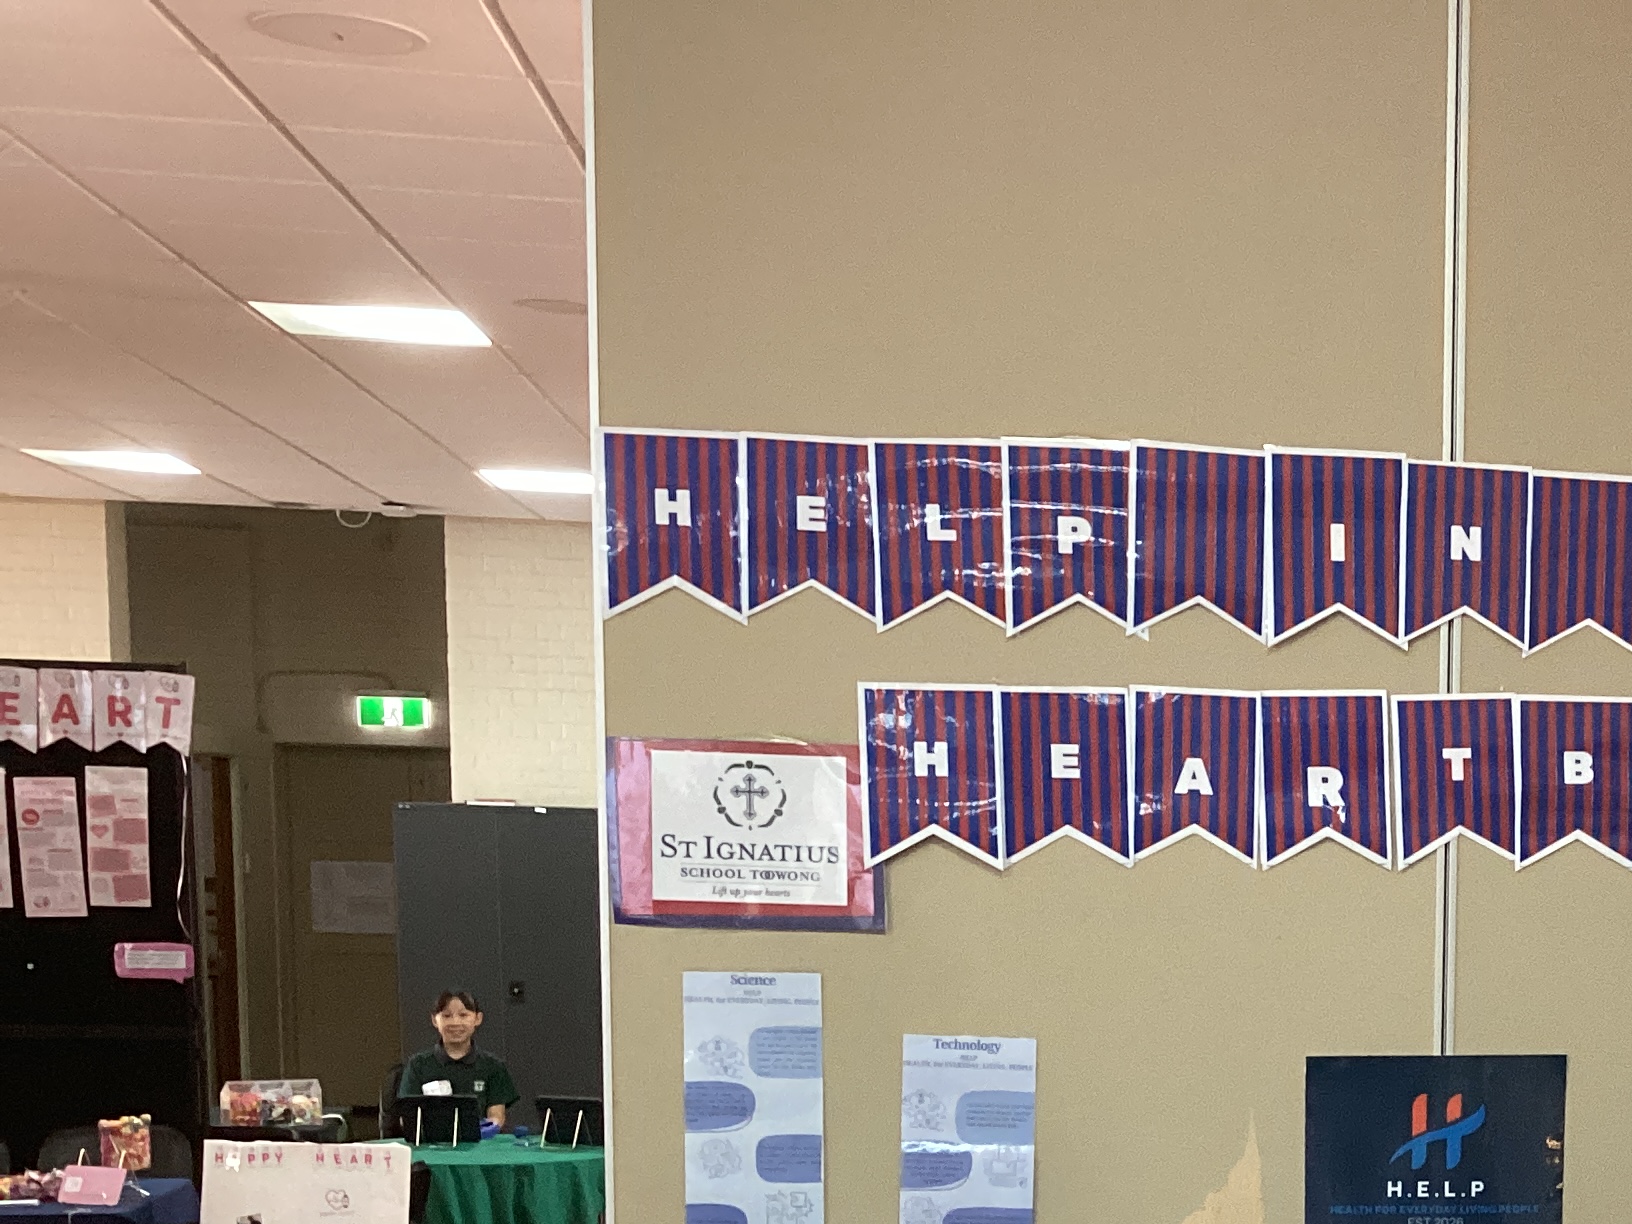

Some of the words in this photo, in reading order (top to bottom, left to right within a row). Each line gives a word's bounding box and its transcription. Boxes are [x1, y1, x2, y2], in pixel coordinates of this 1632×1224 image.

[654, 488, 1092, 555] HELP
[1329, 522, 1483, 563] IN
[680, 867, 746, 879] SCHOOL
[750, 869, 821, 882] TOOWONG
[730, 887, 741, 897] up
[765, 886, 791, 897] hearts
[730, 974, 777, 986] Science
[933, 1038, 1001, 1054] Technology
[215, 1152, 283, 1165] HPPY
[315, 1152, 392, 1168] HEART
